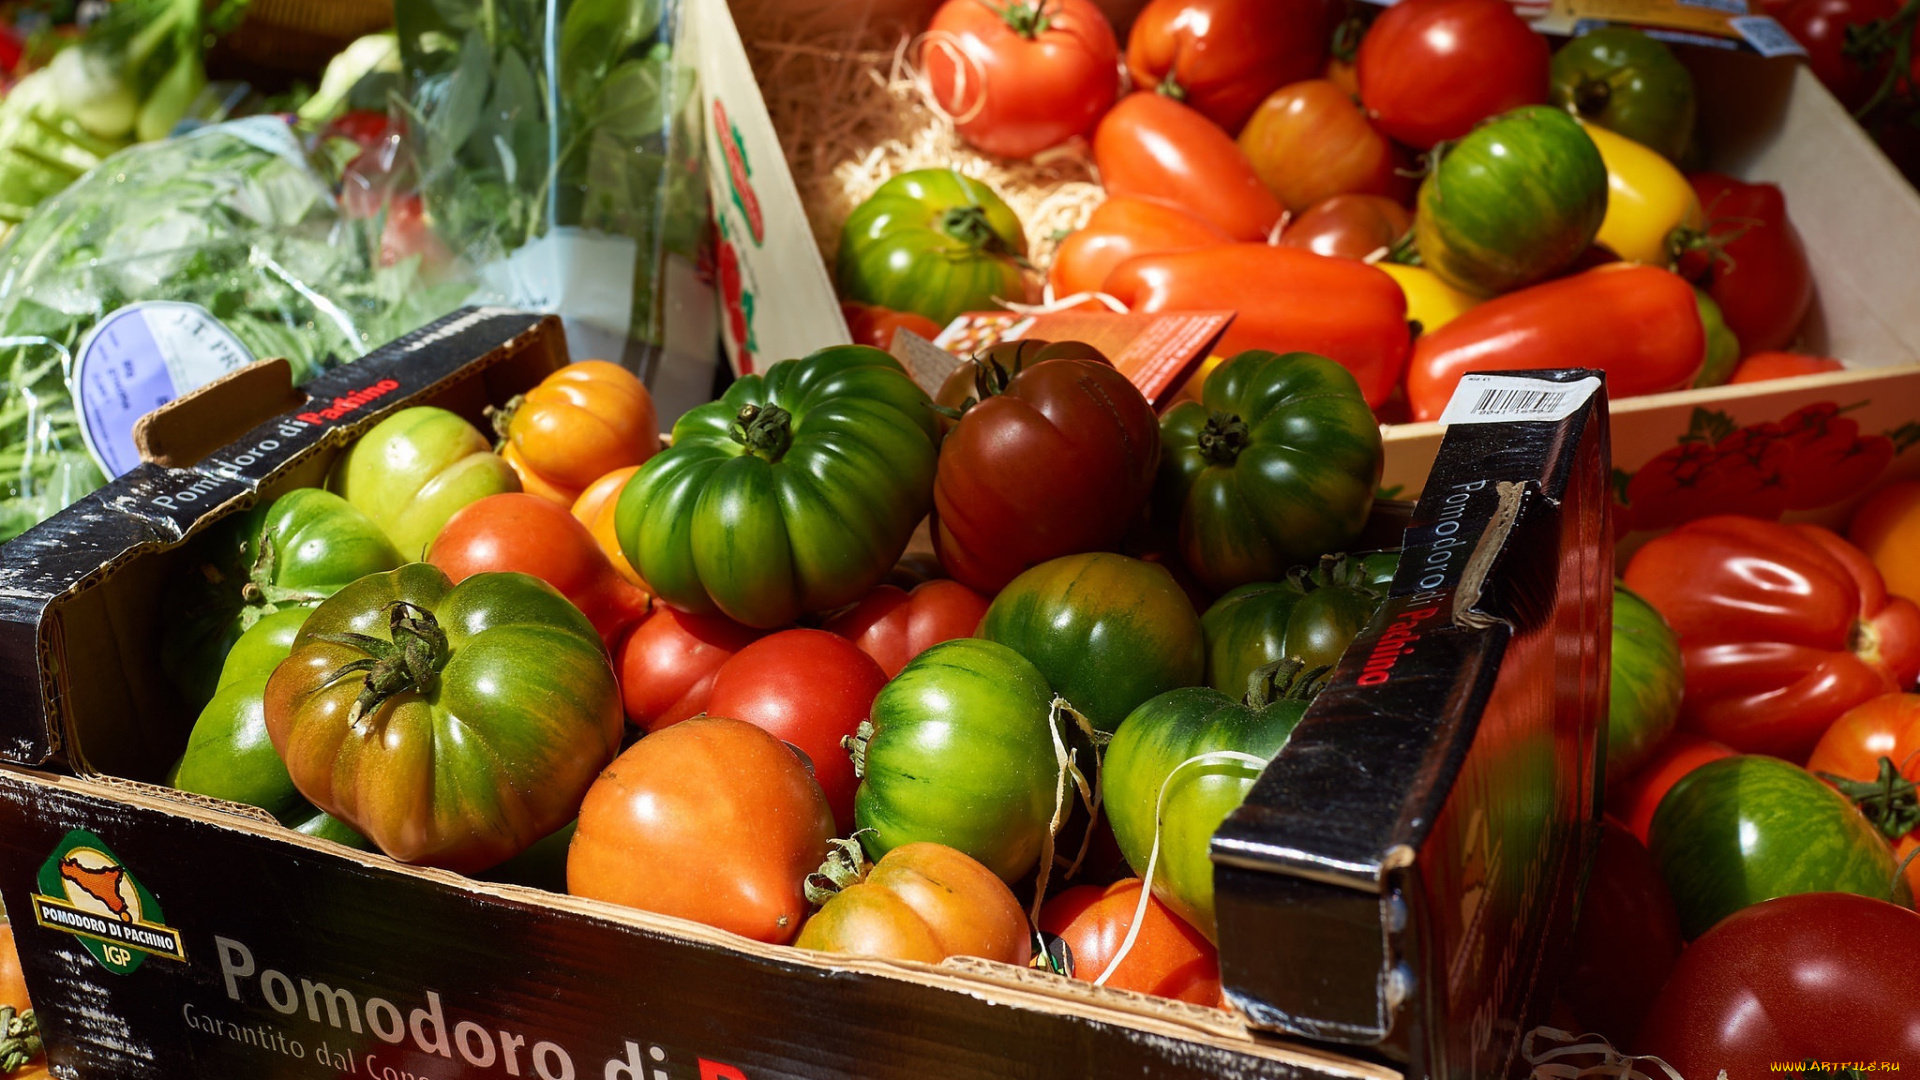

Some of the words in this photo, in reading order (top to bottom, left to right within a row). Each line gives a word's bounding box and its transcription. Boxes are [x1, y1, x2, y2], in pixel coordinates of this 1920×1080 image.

[278, 419, 309, 437] di
[296, 379, 399, 425] Pachino
[1420, 480, 1487, 589] Pomodoro
[1407, 591, 1447, 607] di
[1357, 607, 1439, 686] Pachino
[41, 905, 107, 934] POMODORO
[108, 922, 123, 938] DI
[124, 927, 175, 951] PACHINO
[102, 943, 132, 967] IGP
[214, 934, 576, 1080] Pomodoro
[183, 1003, 305, 1059] Garantito
[315, 1042, 357, 1074] dal
[366, 1054, 430, 1080] Con
